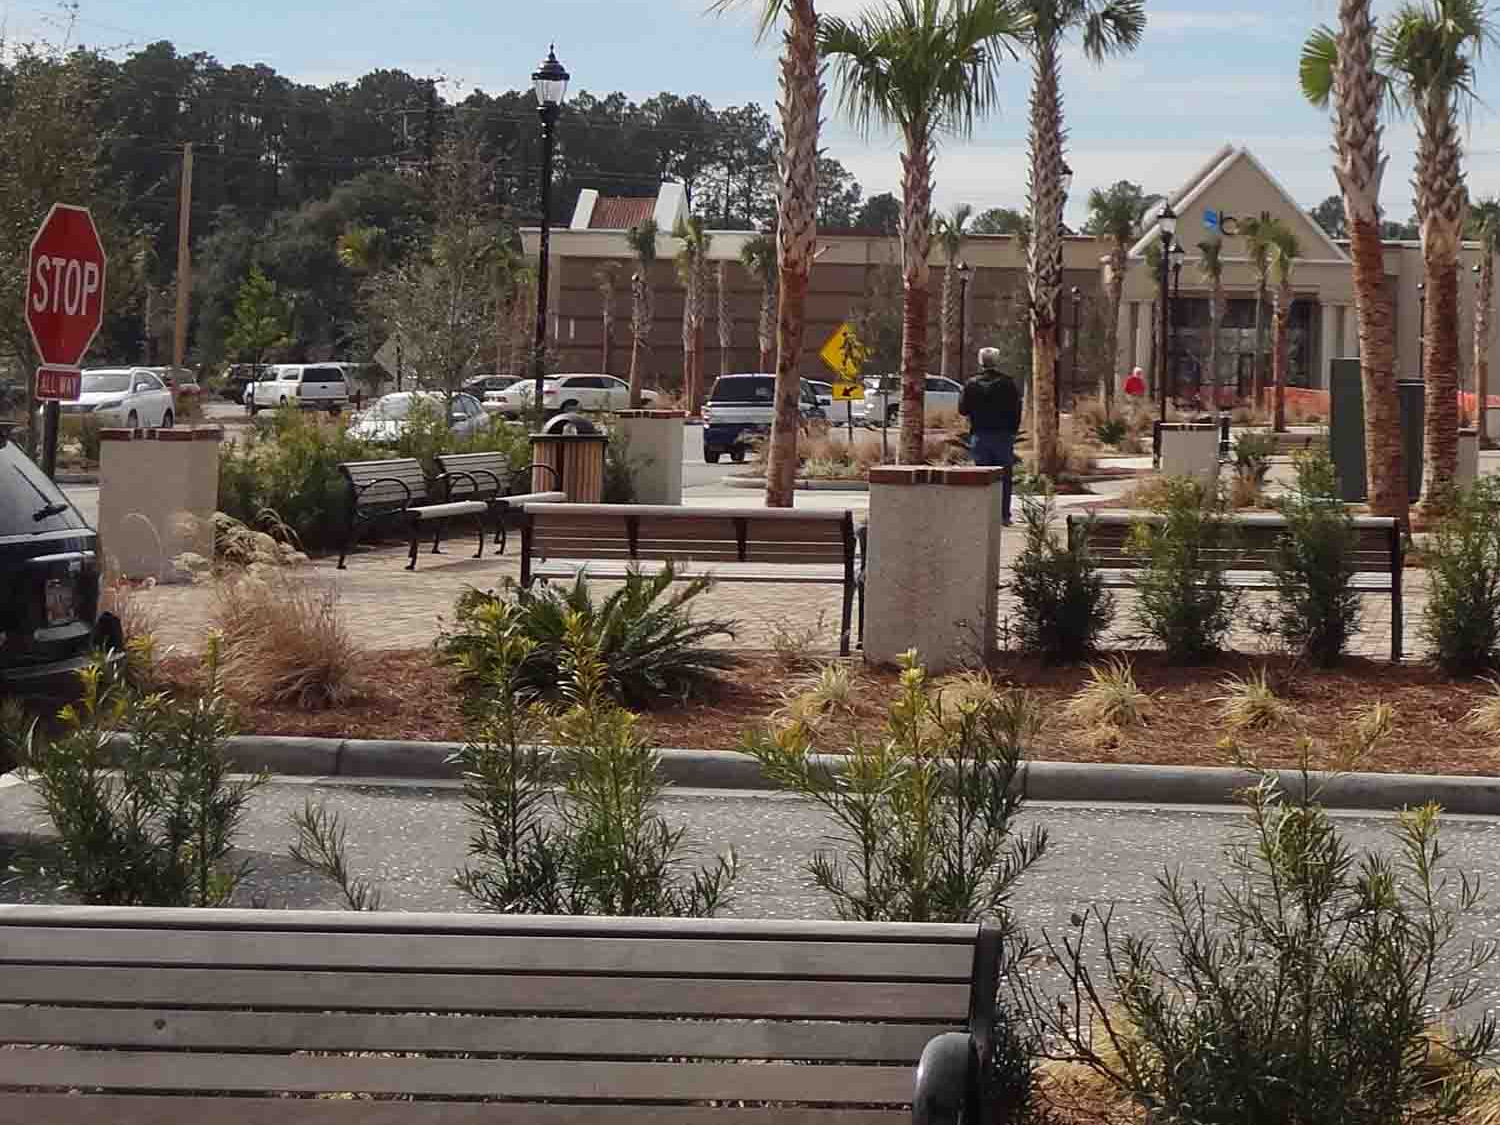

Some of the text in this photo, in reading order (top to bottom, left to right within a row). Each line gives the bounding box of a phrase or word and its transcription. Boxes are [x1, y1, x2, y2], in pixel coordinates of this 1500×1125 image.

[33, 254, 99, 316] STOP
[41, 375, 78, 396] ALL WAY
